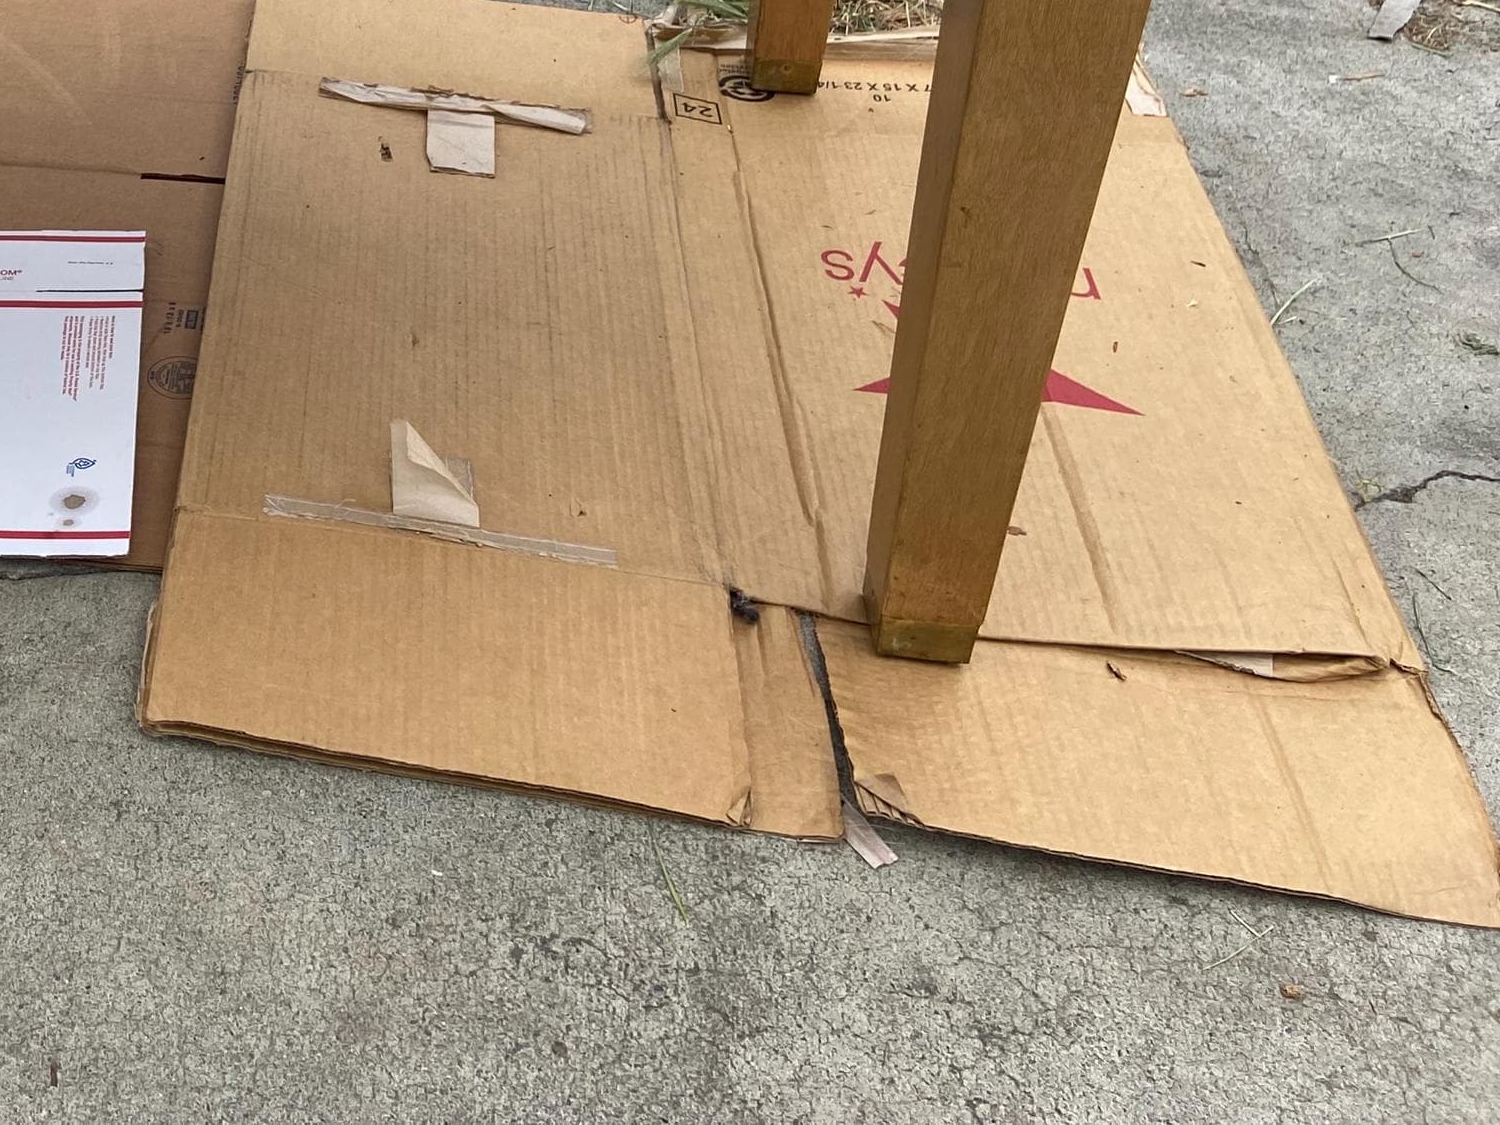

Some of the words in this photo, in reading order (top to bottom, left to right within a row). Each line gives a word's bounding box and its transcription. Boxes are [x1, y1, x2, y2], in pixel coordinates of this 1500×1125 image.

[882, 82, 900, 91] 15
[873, 94, 890, 102] 10
[683, 102, 712, 118] 24
